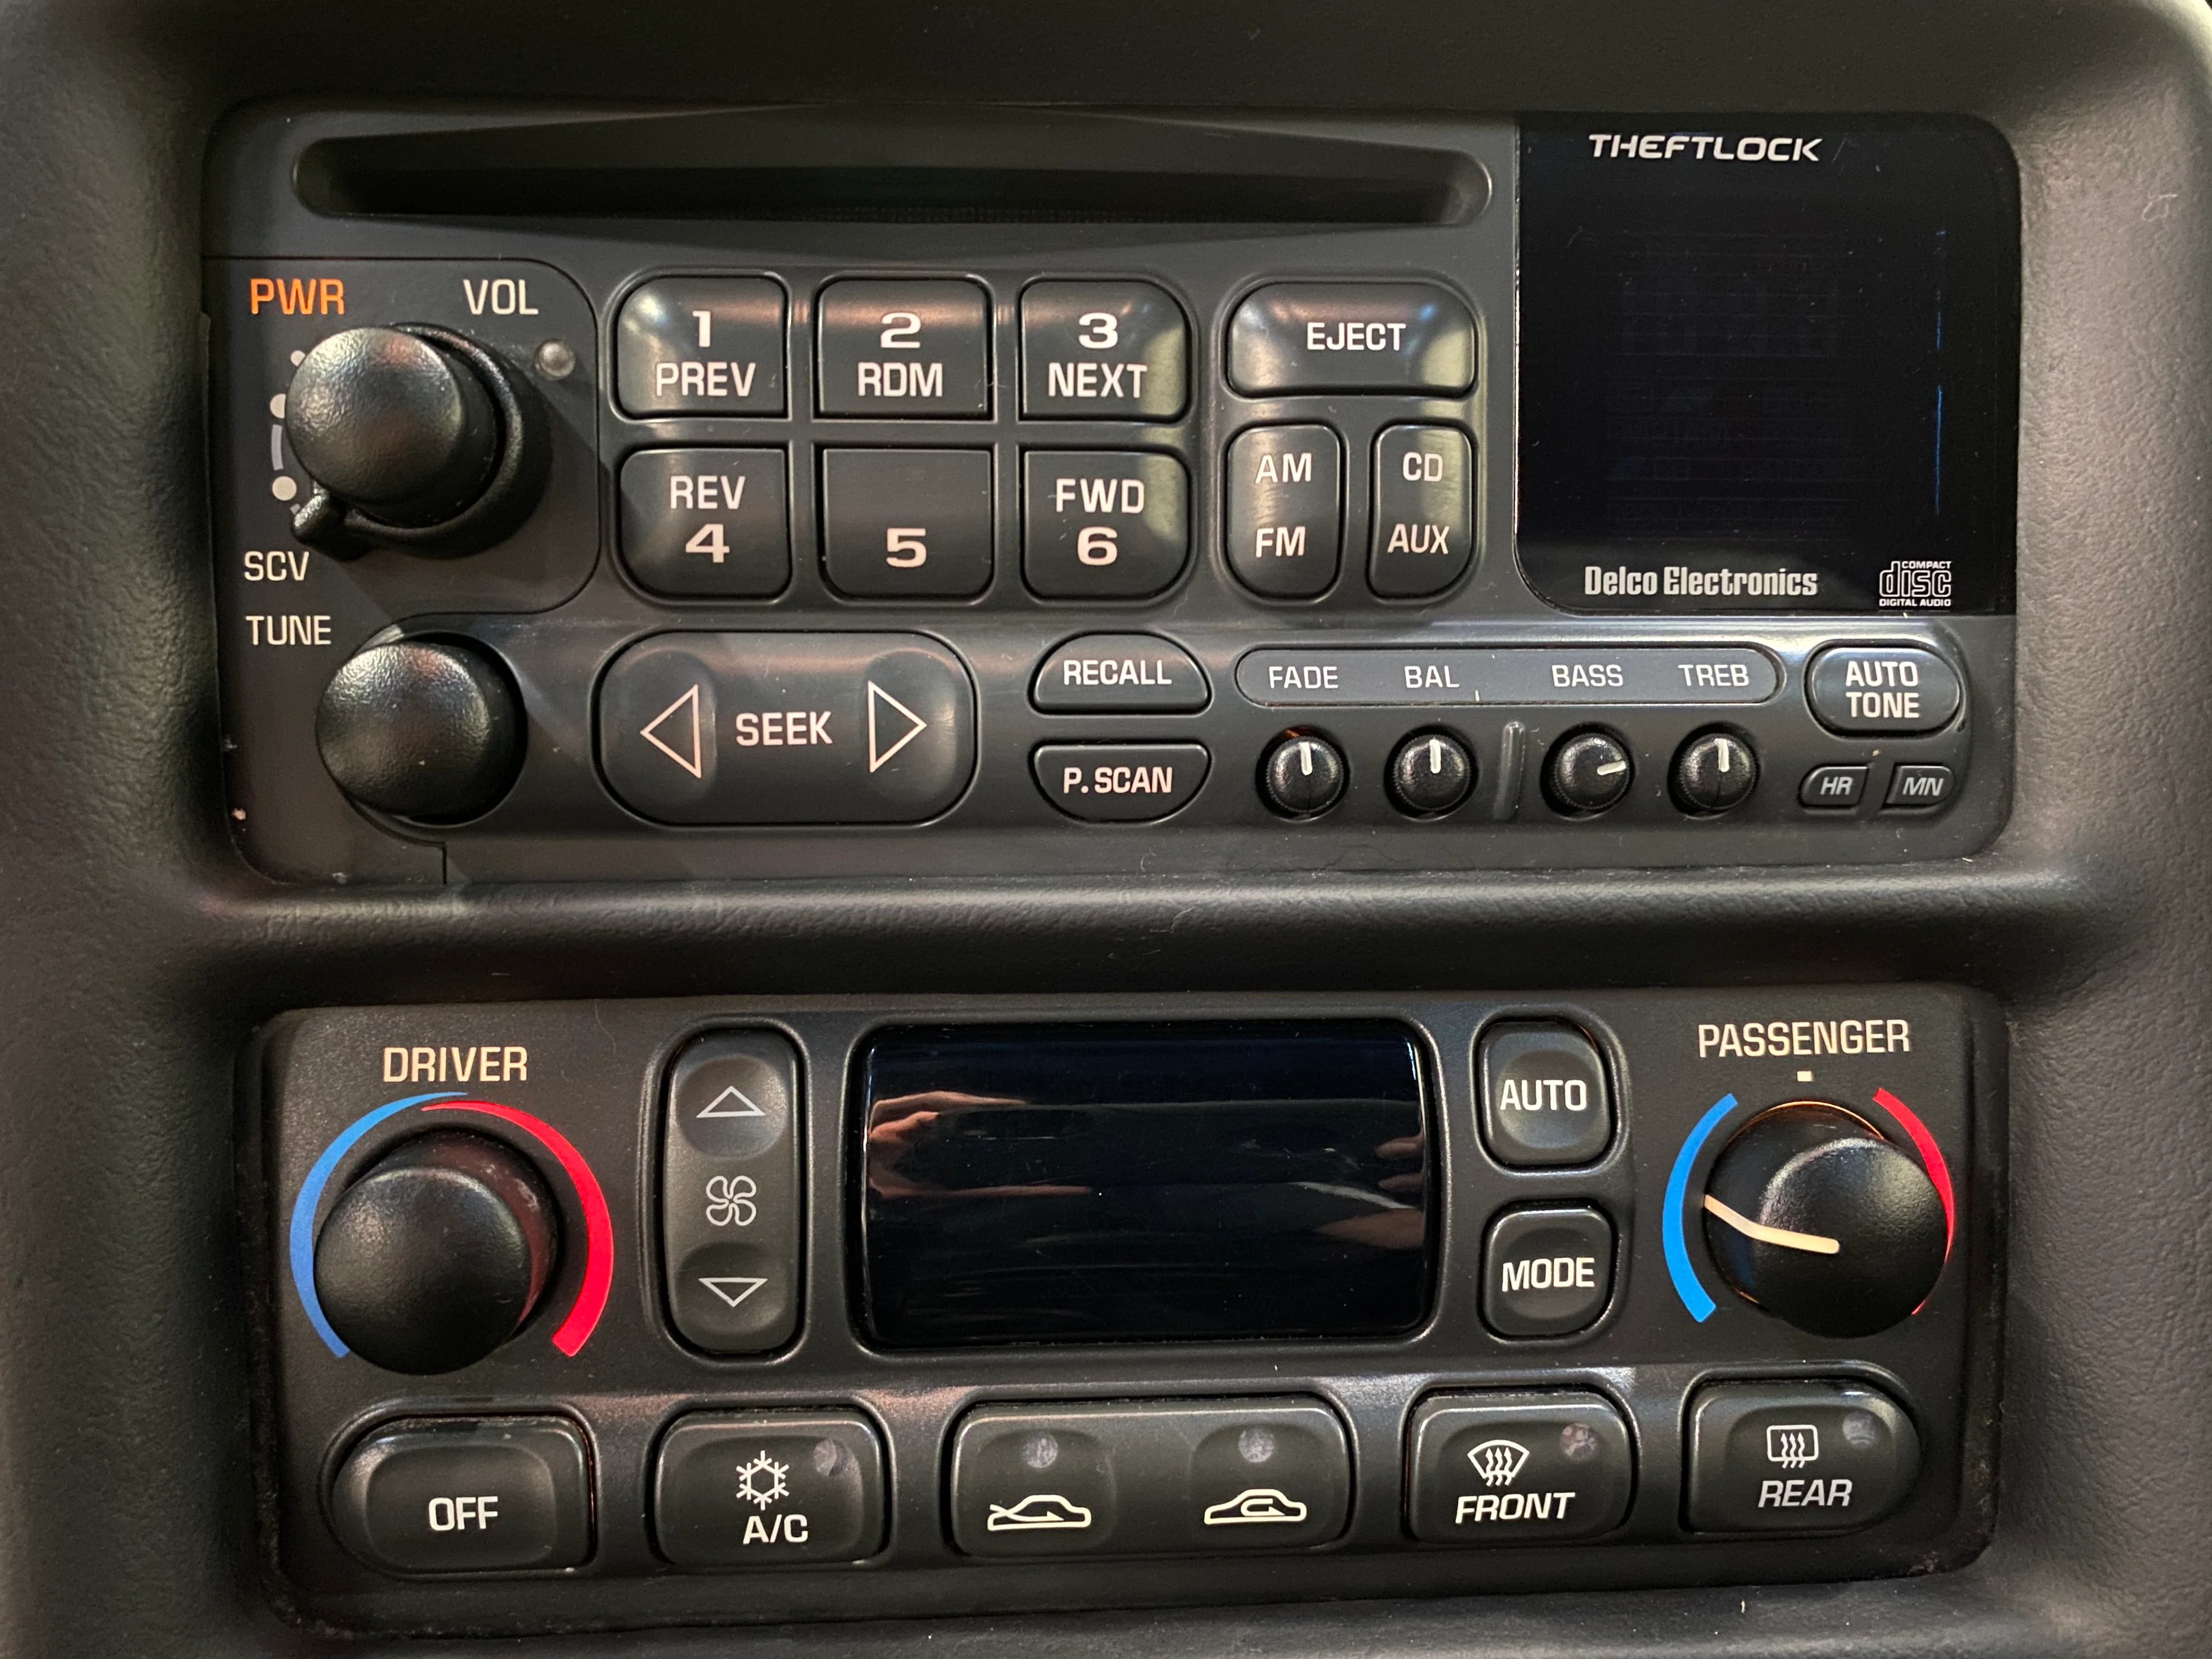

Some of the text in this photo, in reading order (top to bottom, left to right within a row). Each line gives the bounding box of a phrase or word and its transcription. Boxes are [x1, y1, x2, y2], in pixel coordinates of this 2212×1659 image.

[1589, 134, 1823, 162] THEFTLOCK
[250, 278, 346, 315] PWR
[464, 279, 539, 315] VOL
[692, 311, 711, 347] 1
[880, 313, 921, 349] 2
[1078, 313, 1118, 349] 3
[1306, 323, 1407, 351] EJECT
[655, 363, 757, 397] PREV
[857, 363, 943, 397] RDM
[1048, 363, 1148, 397] NEXT
[1255, 453, 1312, 483] AM
[1402, 453, 1444, 482] CD
[670, 476, 746, 510] REV
[1056, 479, 1144, 514] FWD
[685, 523, 730, 563] 4
[886, 528, 927, 568] 5
[1077, 527, 1118, 566] 6
[1255, 527, 1306, 558] FM
[1387, 525, 1450, 554] AUX
[244, 551, 309, 582] SCV
[1585, 566, 1818, 596] Delco Electronics
[1880, 561, 1952, 597] disc
[1880, 599, 1917, 607] DIGITAL
[246, 616, 331, 645] TUNE
[1063, 660, 1172, 685] RECALL
[1269, 667, 1338, 689] FADE
[1404, 666, 1460, 689] BAL
[1551, 664, 1623, 687] BASS
[1678, 664, 1749, 687] TREB
[1845, 661, 1918, 687] AUTO
[1848, 692, 1919, 719] TONE
[736, 711, 833, 746] SEEK
[1820, 777, 1853, 795] HR
[1903, 777, 1942, 797] MN
[1699, 1019, 1910, 1058] PASSENGER
[383, 1047, 527, 1082] DRIVER
[1500, 1079, 1587, 1111] AUTO
[1502, 1257, 1595, 1291] MODE
[1455, 1491, 1575, 1523] FRONT
[1758, 1479, 1852, 1508] REAR
[429, 1496, 498, 1532] OFF
[743, 1514, 809, 1545] A/C
